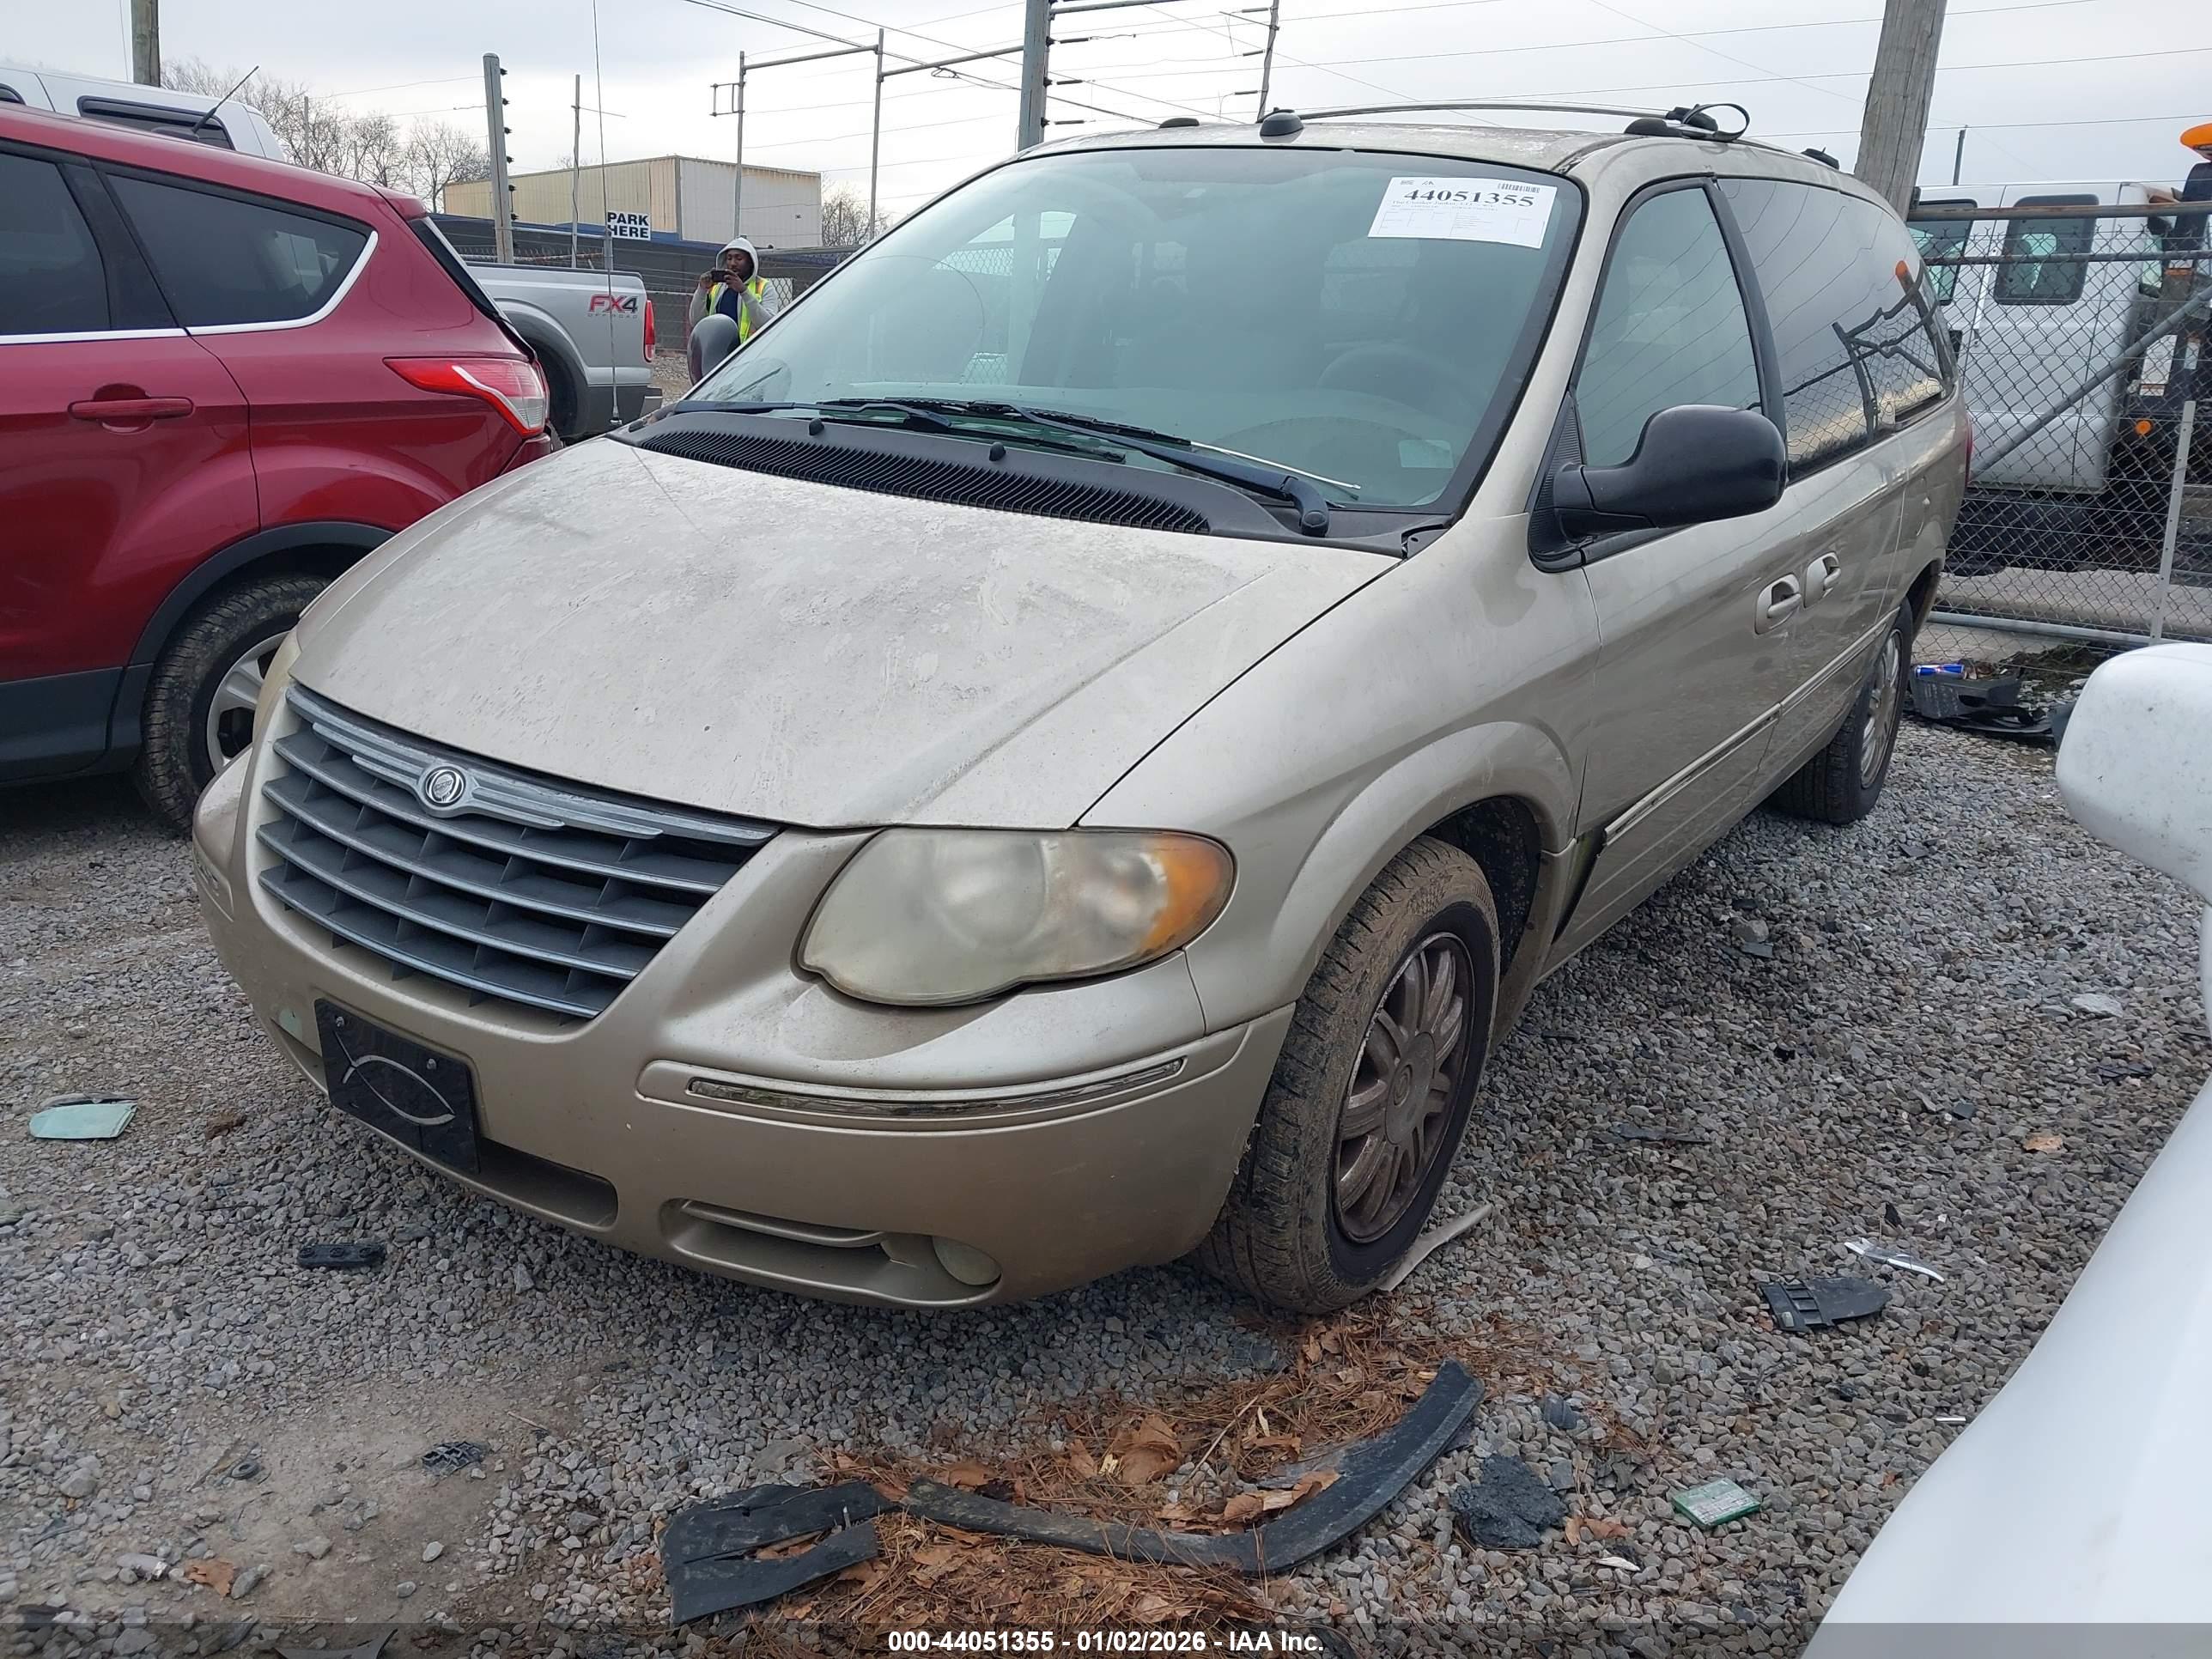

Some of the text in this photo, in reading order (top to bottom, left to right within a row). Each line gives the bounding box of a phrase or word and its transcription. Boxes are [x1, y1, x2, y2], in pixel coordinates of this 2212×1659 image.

[1403, 189, 1534, 207] 44051355
[607, 211, 649, 227] PARK
[606, 224, 649, 239] HERE
[588, 295, 639, 313] FX4
